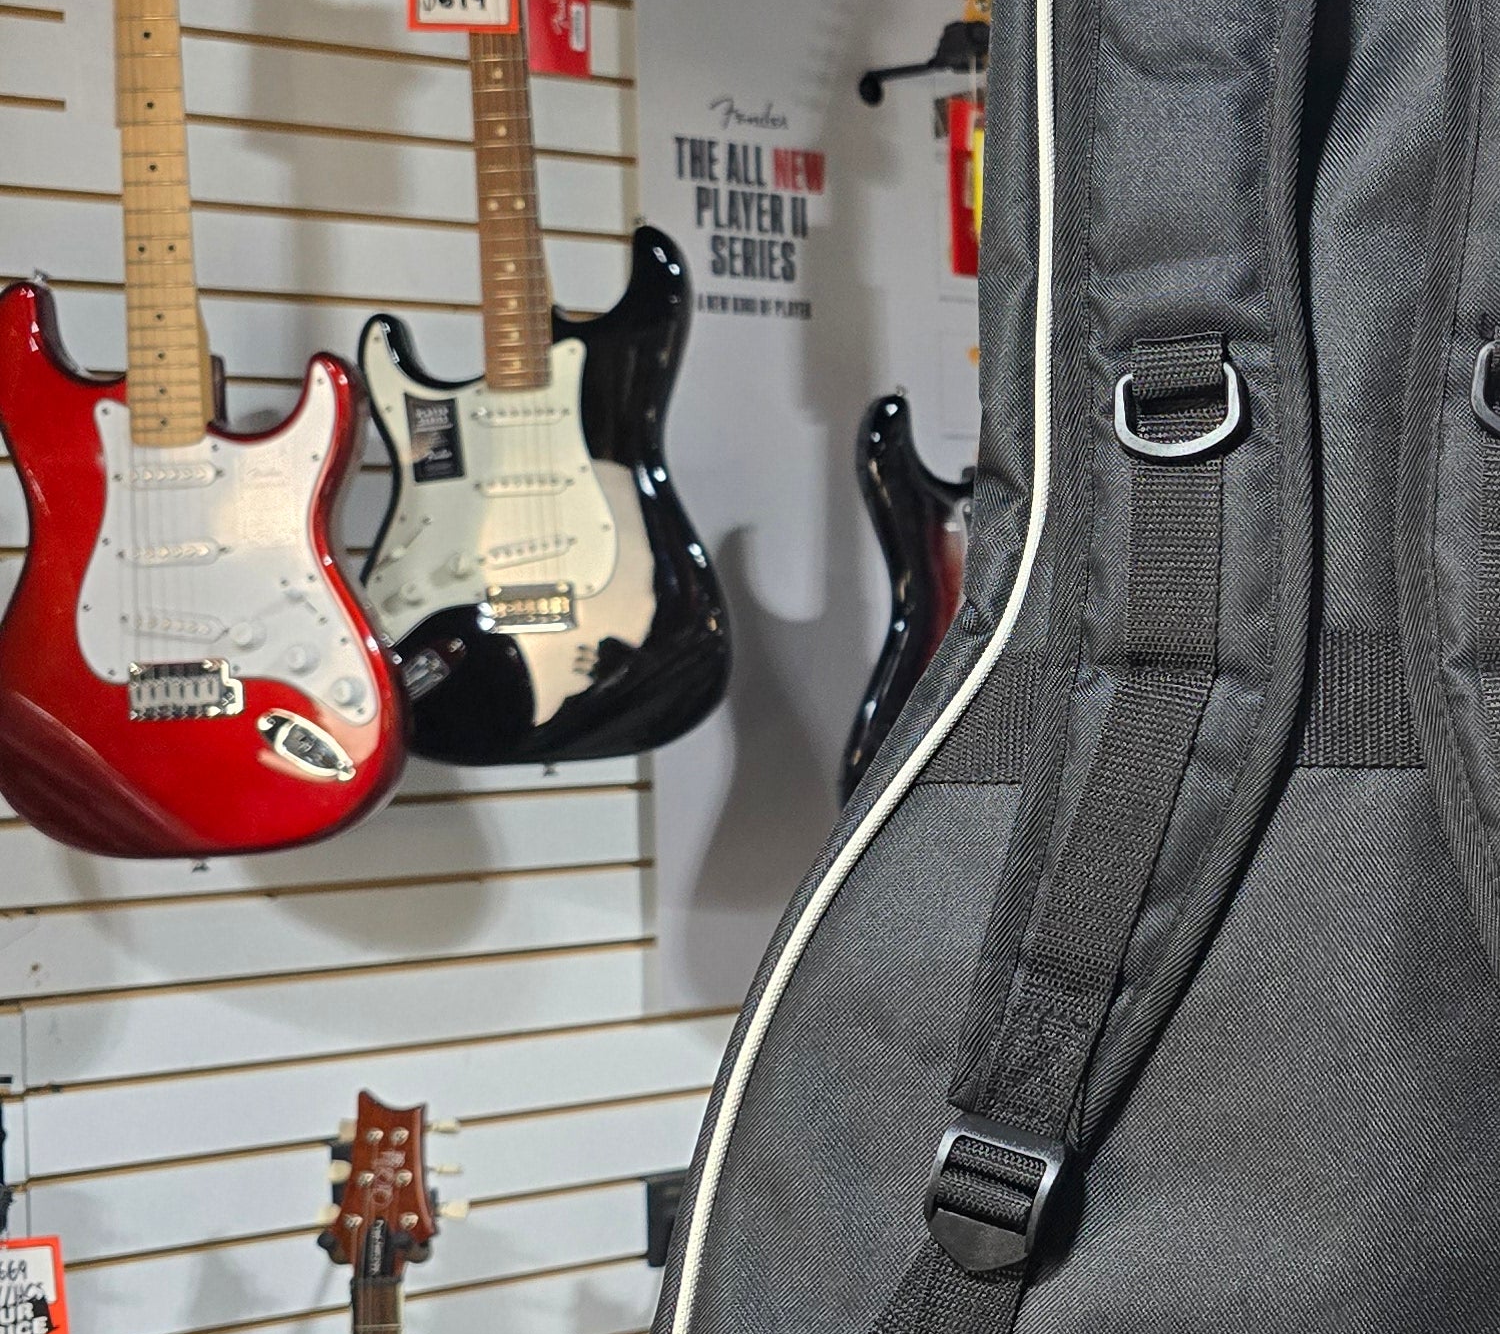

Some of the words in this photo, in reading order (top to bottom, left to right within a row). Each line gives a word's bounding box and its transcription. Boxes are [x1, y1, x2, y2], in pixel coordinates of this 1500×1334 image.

[709, 94, 789, 130] Fender
[674, 136, 719, 181] THE
[726, 142, 767, 187] ALL
[772, 147, 826, 196] NEW
[696, 185, 785, 235] PLAYER
[790, 195, 809, 239] II
[710, 233, 797, 283] SERIES
[0, 1301, 35, 1325] UR
